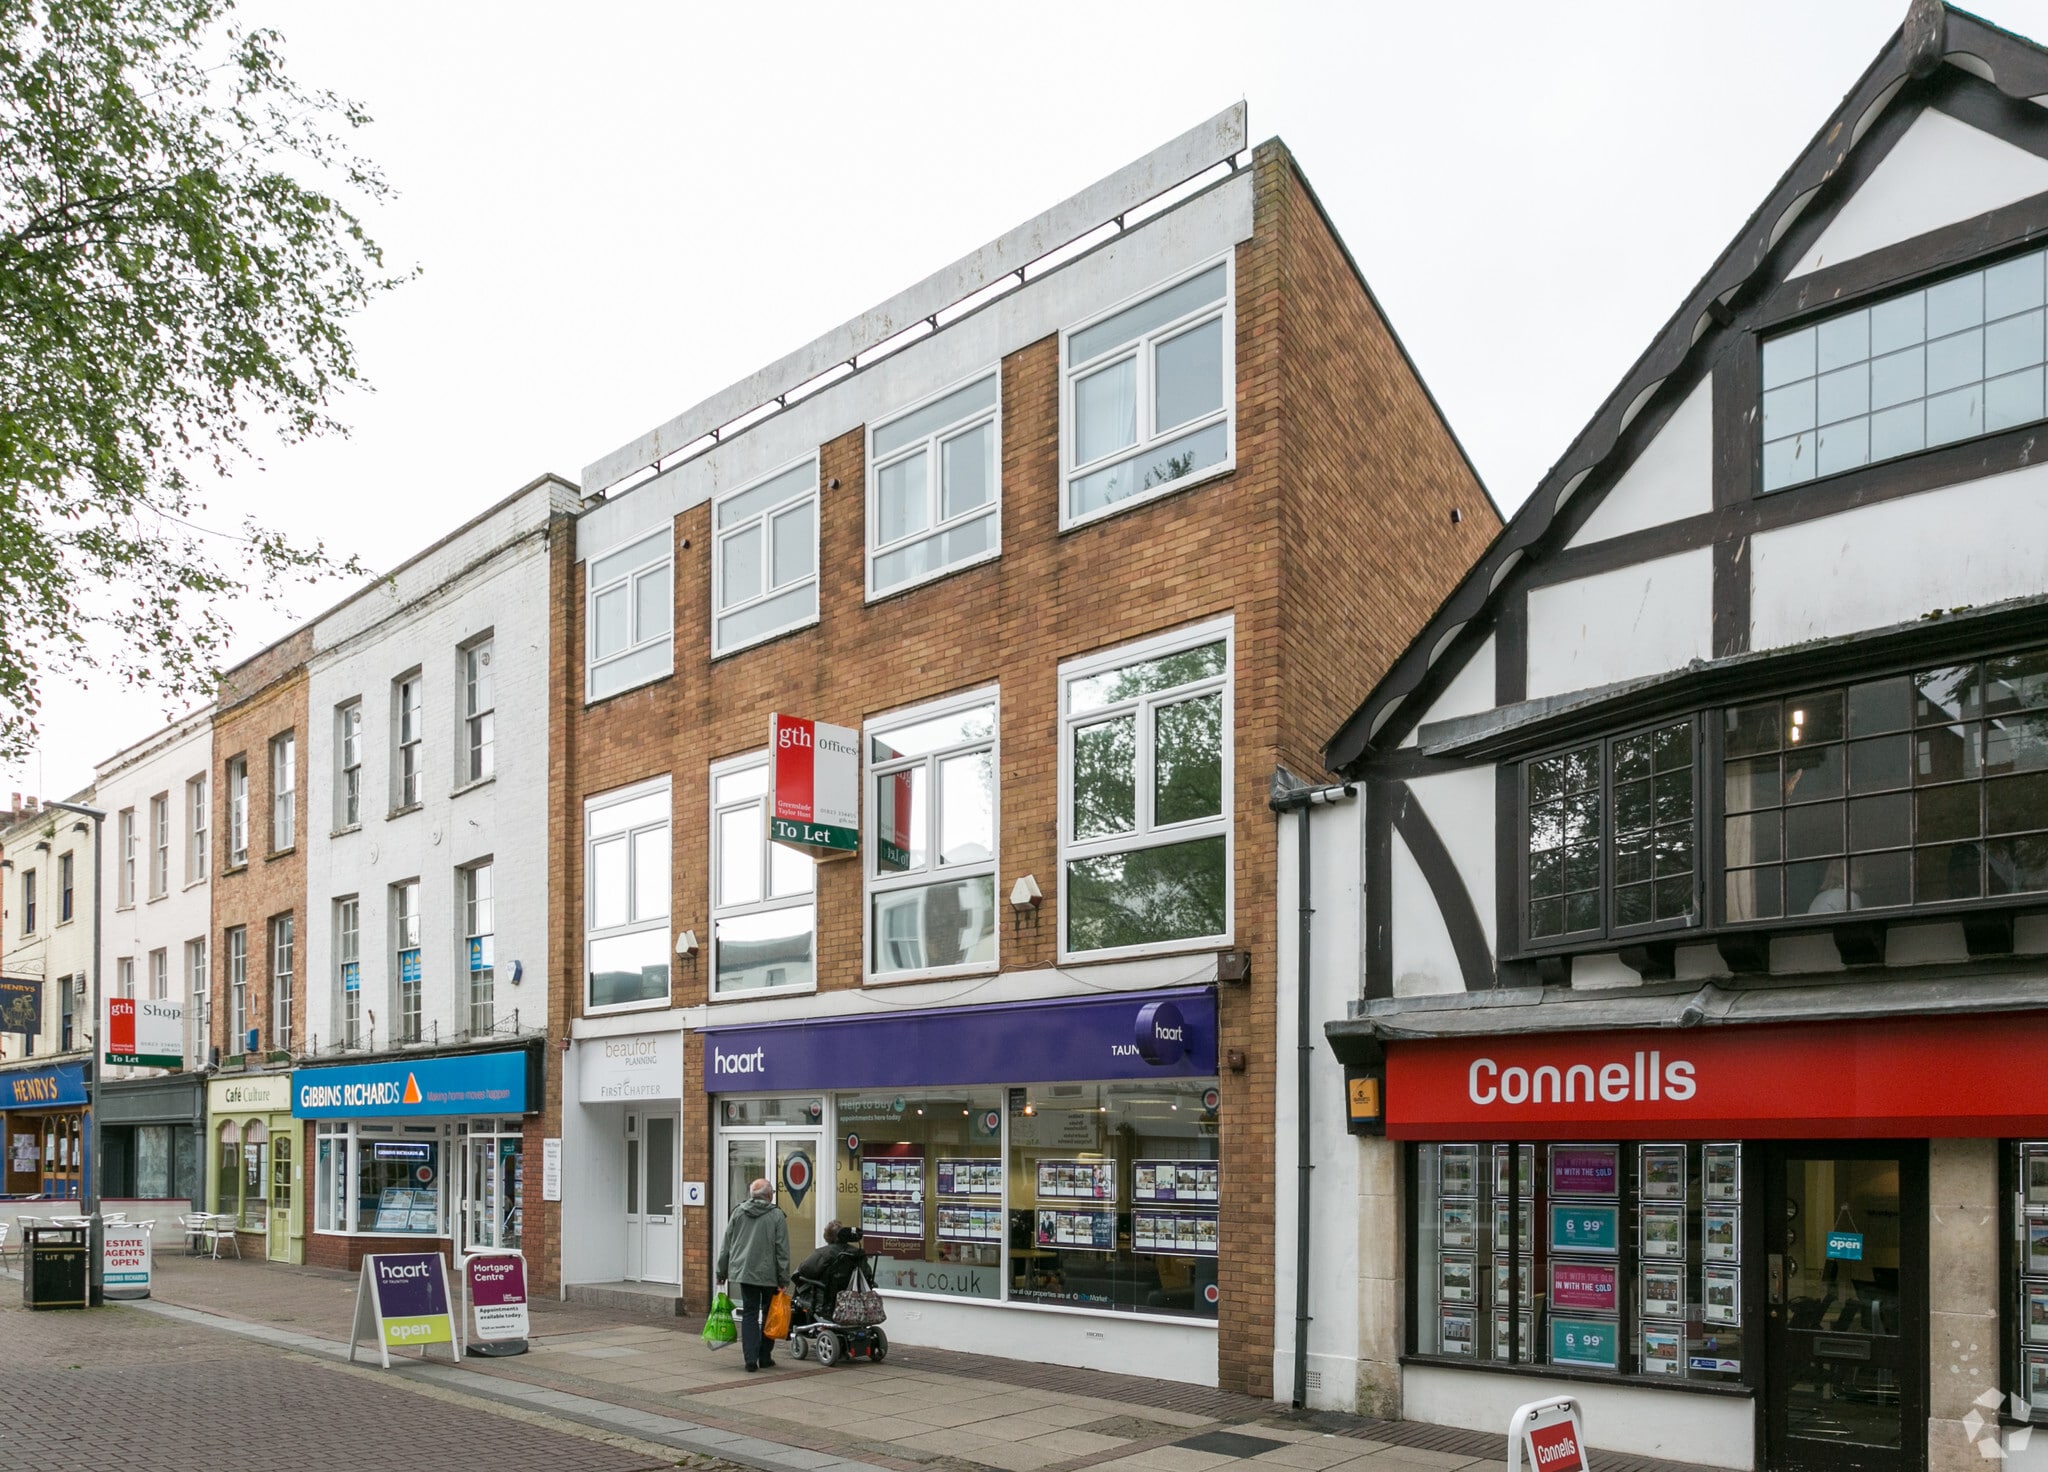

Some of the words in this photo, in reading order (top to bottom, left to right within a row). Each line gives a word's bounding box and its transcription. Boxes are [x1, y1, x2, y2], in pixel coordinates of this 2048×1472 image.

[779, 726, 812, 749] gth
[819, 738, 857, 756] Offices
[776, 820, 797, 838] To
[803, 825, 831, 843] Let
[0, 983, 36, 993] HENRYS
[111, 1002, 134, 1016] gth
[143, 1004, 181, 1020] Shop
[1155, 1021, 1183, 1042] haart
[605, 1038, 657, 1058] beaufort
[125, 1055, 139, 1063] Let
[625, 1056, 657, 1066] PLANNING
[714, 1046, 765, 1074] haart
[1468, 1050, 1697, 1105] Connells
[12, 1076, 58, 1102] HENRYS
[225, 1086, 241, 1103] Café
[243, 1086, 270, 1102] Culture
[300, 1084, 342, 1108] GIBBINS
[344, 1082, 400, 1106] RICHARDS
[1556, 1168, 1562, 1176] IN
[1563, 1168, 1580, 1176] WITH
[1582, 1168, 1594, 1176] THE
[1595, 1168, 1612, 1177] SOLD
[836, 1178, 859, 1193] ales
[1566, 1219, 1575, 1230] 6
[106, 1239, 143, 1247] ESTATE
[1829, 1239, 1861, 1250] open
[105, 1249, 145, 1257] AGENTS
[111, 1258, 140, 1267] OPEN
[379, 1260, 429, 1279] haart
[473, 1263, 514, 1273] Mortgage
[475, 1272, 504, 1281] Centre
[1569, 1272, 1586, 1281] WITH
[1587, 1273, 1600, 1282] THE
[1563, 1282, 1580, 1290] WITH
[1581, 1283, 1593, 1291] THE
[1595, 1284, 1612, 1292] SOLD
[480, 1306, 519, 1314] Appointments
[390, 1322, 431, 1340] open
[1565, 1333, 1574, 1344] 6
[1537, 1437, 1576, 1465] Connells
